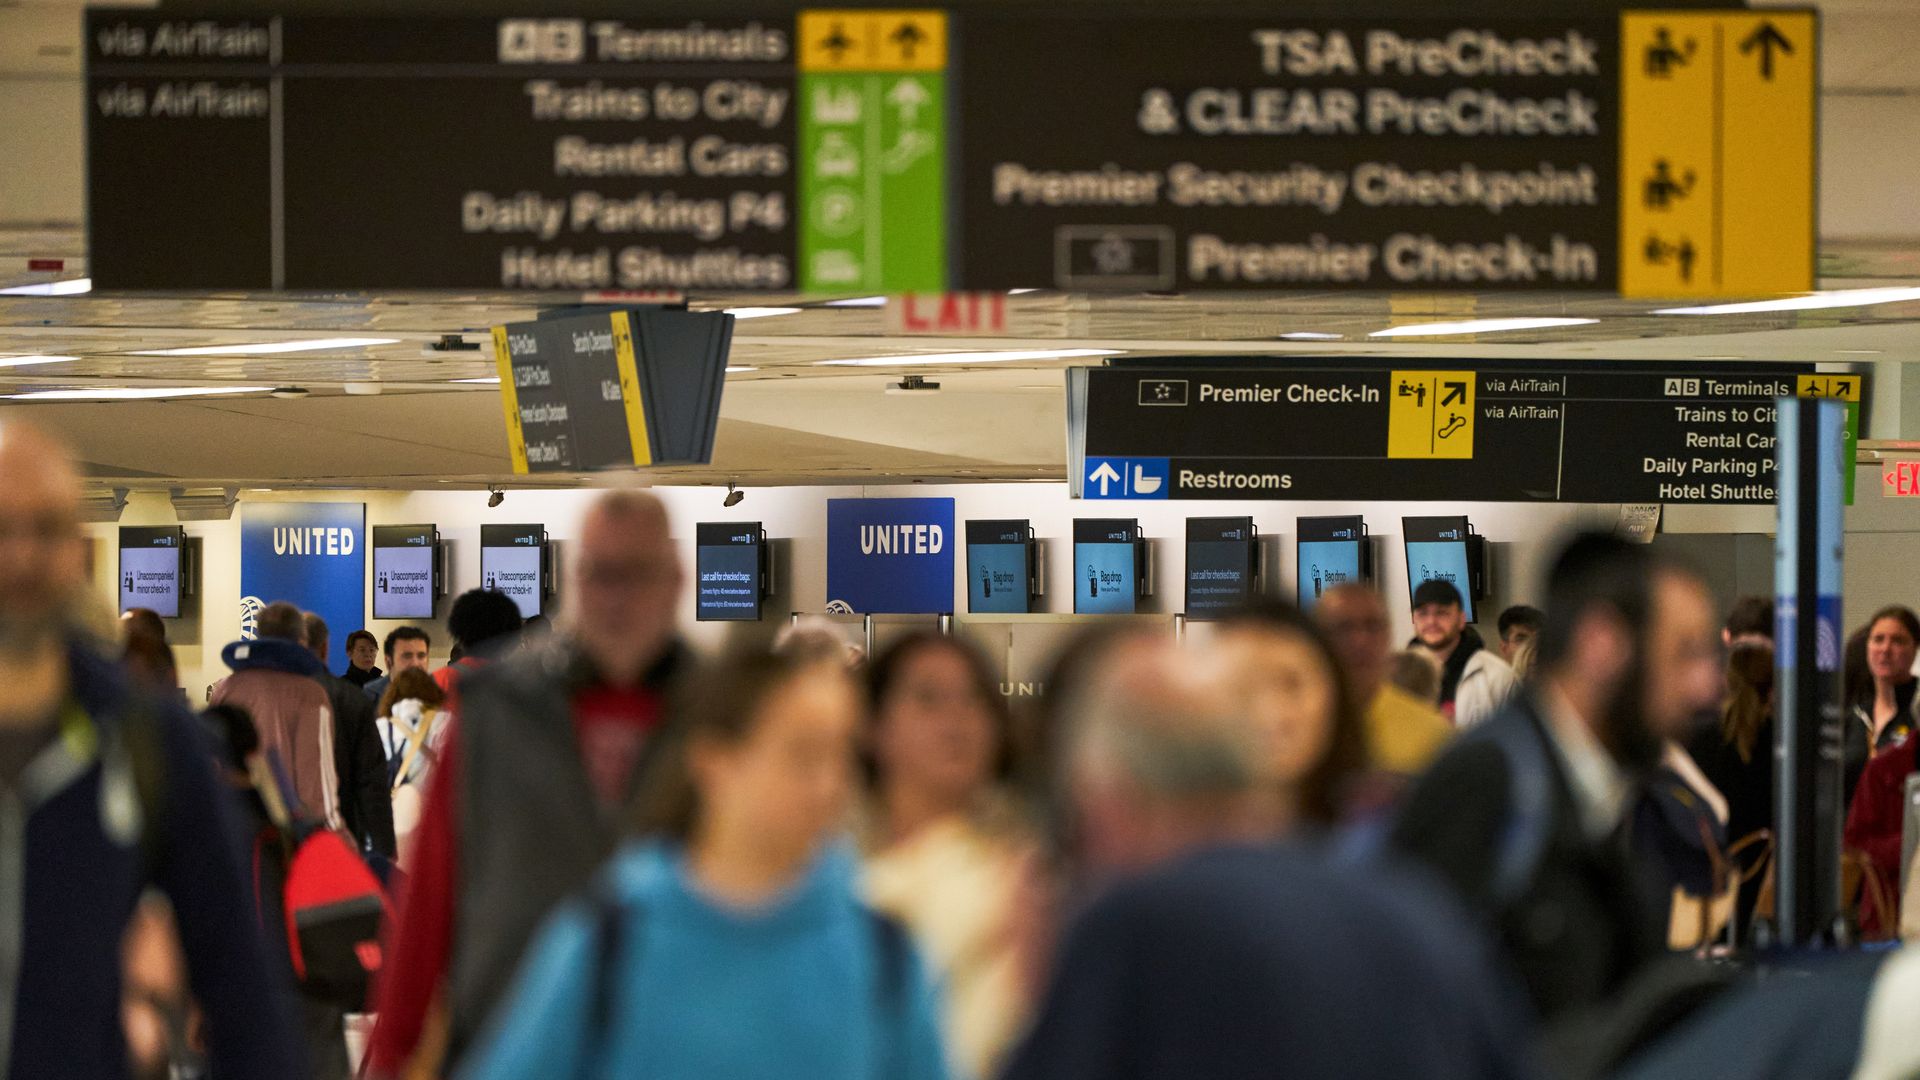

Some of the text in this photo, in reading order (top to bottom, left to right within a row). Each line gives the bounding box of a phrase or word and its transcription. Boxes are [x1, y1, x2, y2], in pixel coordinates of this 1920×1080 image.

[98, 22, 267, 56] via AirTrain
[593, 22, 786, 60] Terminals
[1255, 31, 1597, 75] TSA PreCheck
[98, 83, 267, 117] via AirTrain
[527, 81, 788, 127] Trains to City
[1139, 89, 1597, 134] & CLEAR PreCheck
[555, 137, 787, 176] Rental Cars
[994, 162, 1596, 213] Premier Security Checkpoint
[462, 192, 786, 240] Daily Parking P4
[1189, 234, 1597, 280] Premier Check-In
[501, 248, 787, 287] Hotel Shuttles
[1199, 383, 1380, 403] Premier Check-In
[1486, 379, 1560, 392] via AirTrain
[1705, 380, 1790, 396] Terminals
[1485, 405, 1559, 419] via AirTrain
[1674, 407, 1777, 423] Trains to Cit
[1686, 432, 1777, 449] Rental Car
[1643, 458, 1687, 477] Daily
[1692, 458, 1758, 478] Parking
[1179, 469, 1292, 489] Restrooms
[1896, 463, 1920, 496] EX
[1659, 484, 1706, 499] Hotel
[274, 527, 355, 556] UNITED
[861, 524, 944, 555] UNITED
[137, 570, 175, 583] Unaccompanied
[391, 569, 428, 583] Unaccompanied
[499, 569, 536, 583] Unaccompanied
[993, 570, 1015, 586] Bag drop
[1100, 570, 1122, 585] Bag drop
[1324, 569, 1334, 584] Bag
[137, 585, 149, 594] minor
[391, 584, 425, 595] minor check-in
[1000, 682, 1043, 696] UNI
